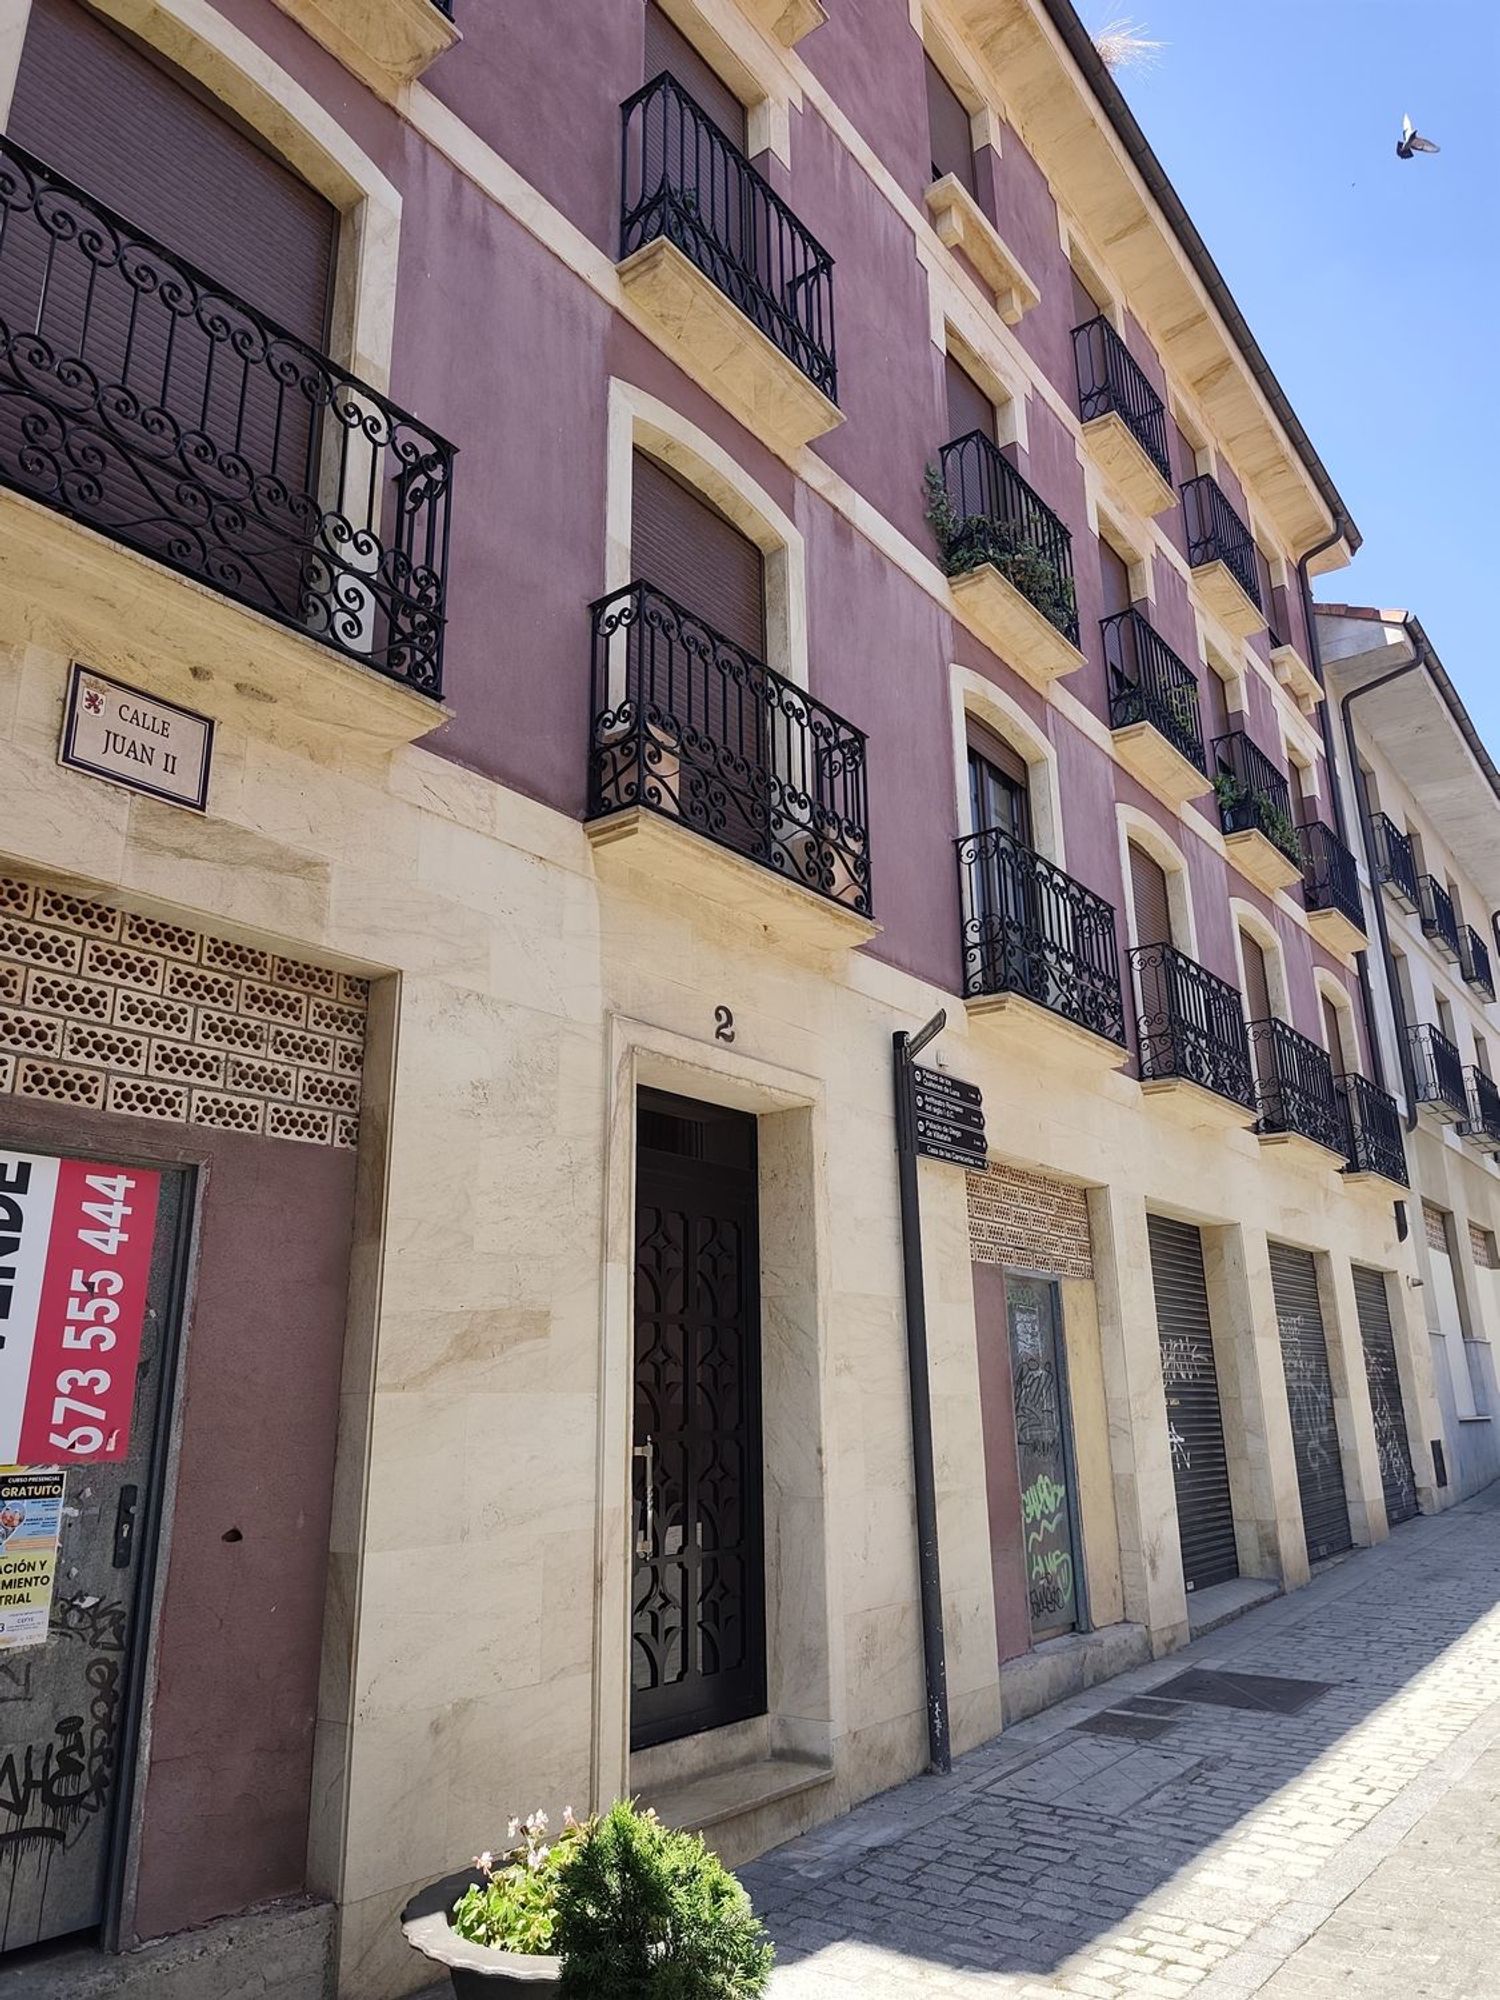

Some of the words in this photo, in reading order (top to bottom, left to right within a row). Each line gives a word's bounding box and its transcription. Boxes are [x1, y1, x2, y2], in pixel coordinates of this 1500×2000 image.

[119, 704, 171, 739] CALLE
[102, 729, 155, 766] JUAN
[163, 753, 178, 775] II
[714, 1005, 735, 1043] 2
[77, 1174, 136, 1255] 444
[62, 1269, 125, 1352] 555
[49, 1368, 112, 1455] 673
[1, 1485, 62, 1497] GRATUITO
[39, 1560, 47, 1571] Y
